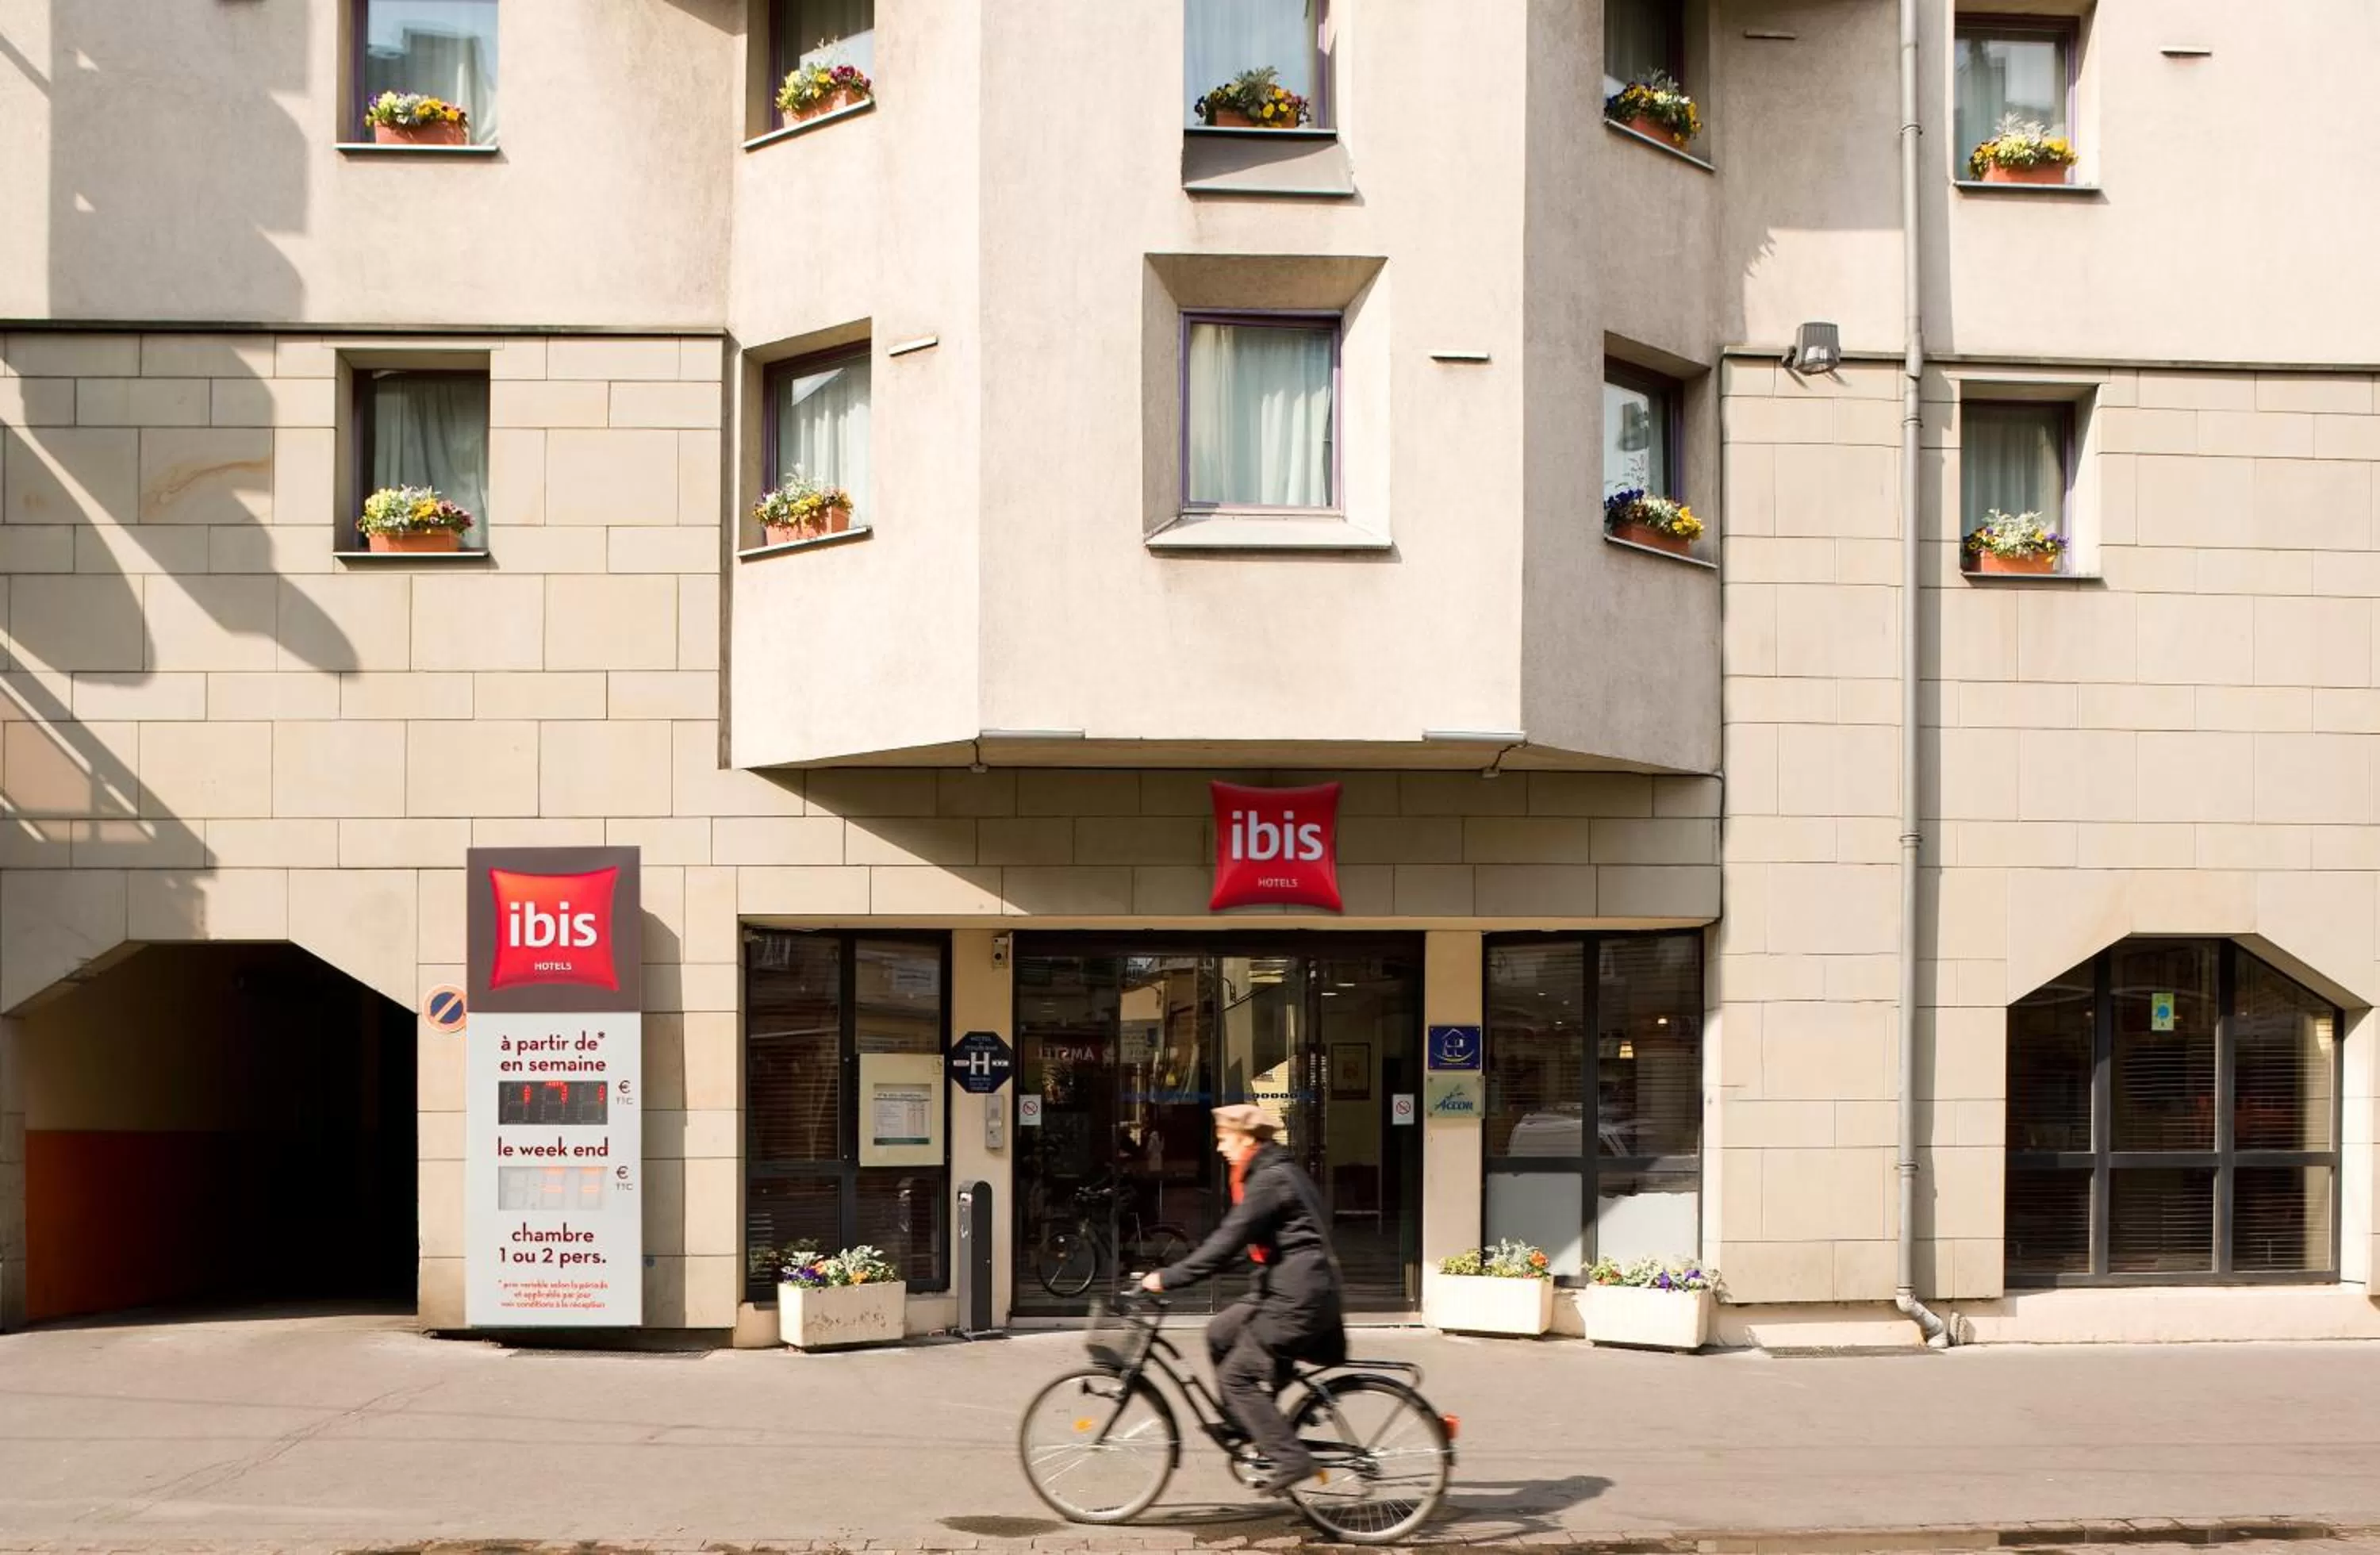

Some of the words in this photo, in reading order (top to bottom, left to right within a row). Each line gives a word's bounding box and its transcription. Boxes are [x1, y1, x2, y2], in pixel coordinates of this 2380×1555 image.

[1232, 810, 1323, 861] ibis
[1257, 877, 1299, 888] HOTELS
[509, 901, 598, 947] ibis
[534, 962, 572, 971] HOTELS
[501, 1035, 512, 1051] à
[517, 1034, 569, 1056] partir
[501, 1060, 523, 1072] en
[529, 1055, 607, 1072] semaine
[970, 1052, 991, 1076] H
[619, 1080, 631, 1094] €
[498, 1136, 514, 1157] le
[519, 1136, 568, 1157] week
[574, 1136, 608, 1157] end
[616, 1165, 629, 1180] €
[512, 1222, 594, 1242] chambre
[499, 1247, 506, 1262] 1
[512, 1252, 536, 1264] ou
[542, 1247, 554, 1263] 2
[559, 1252, 607, 1269] pers.
